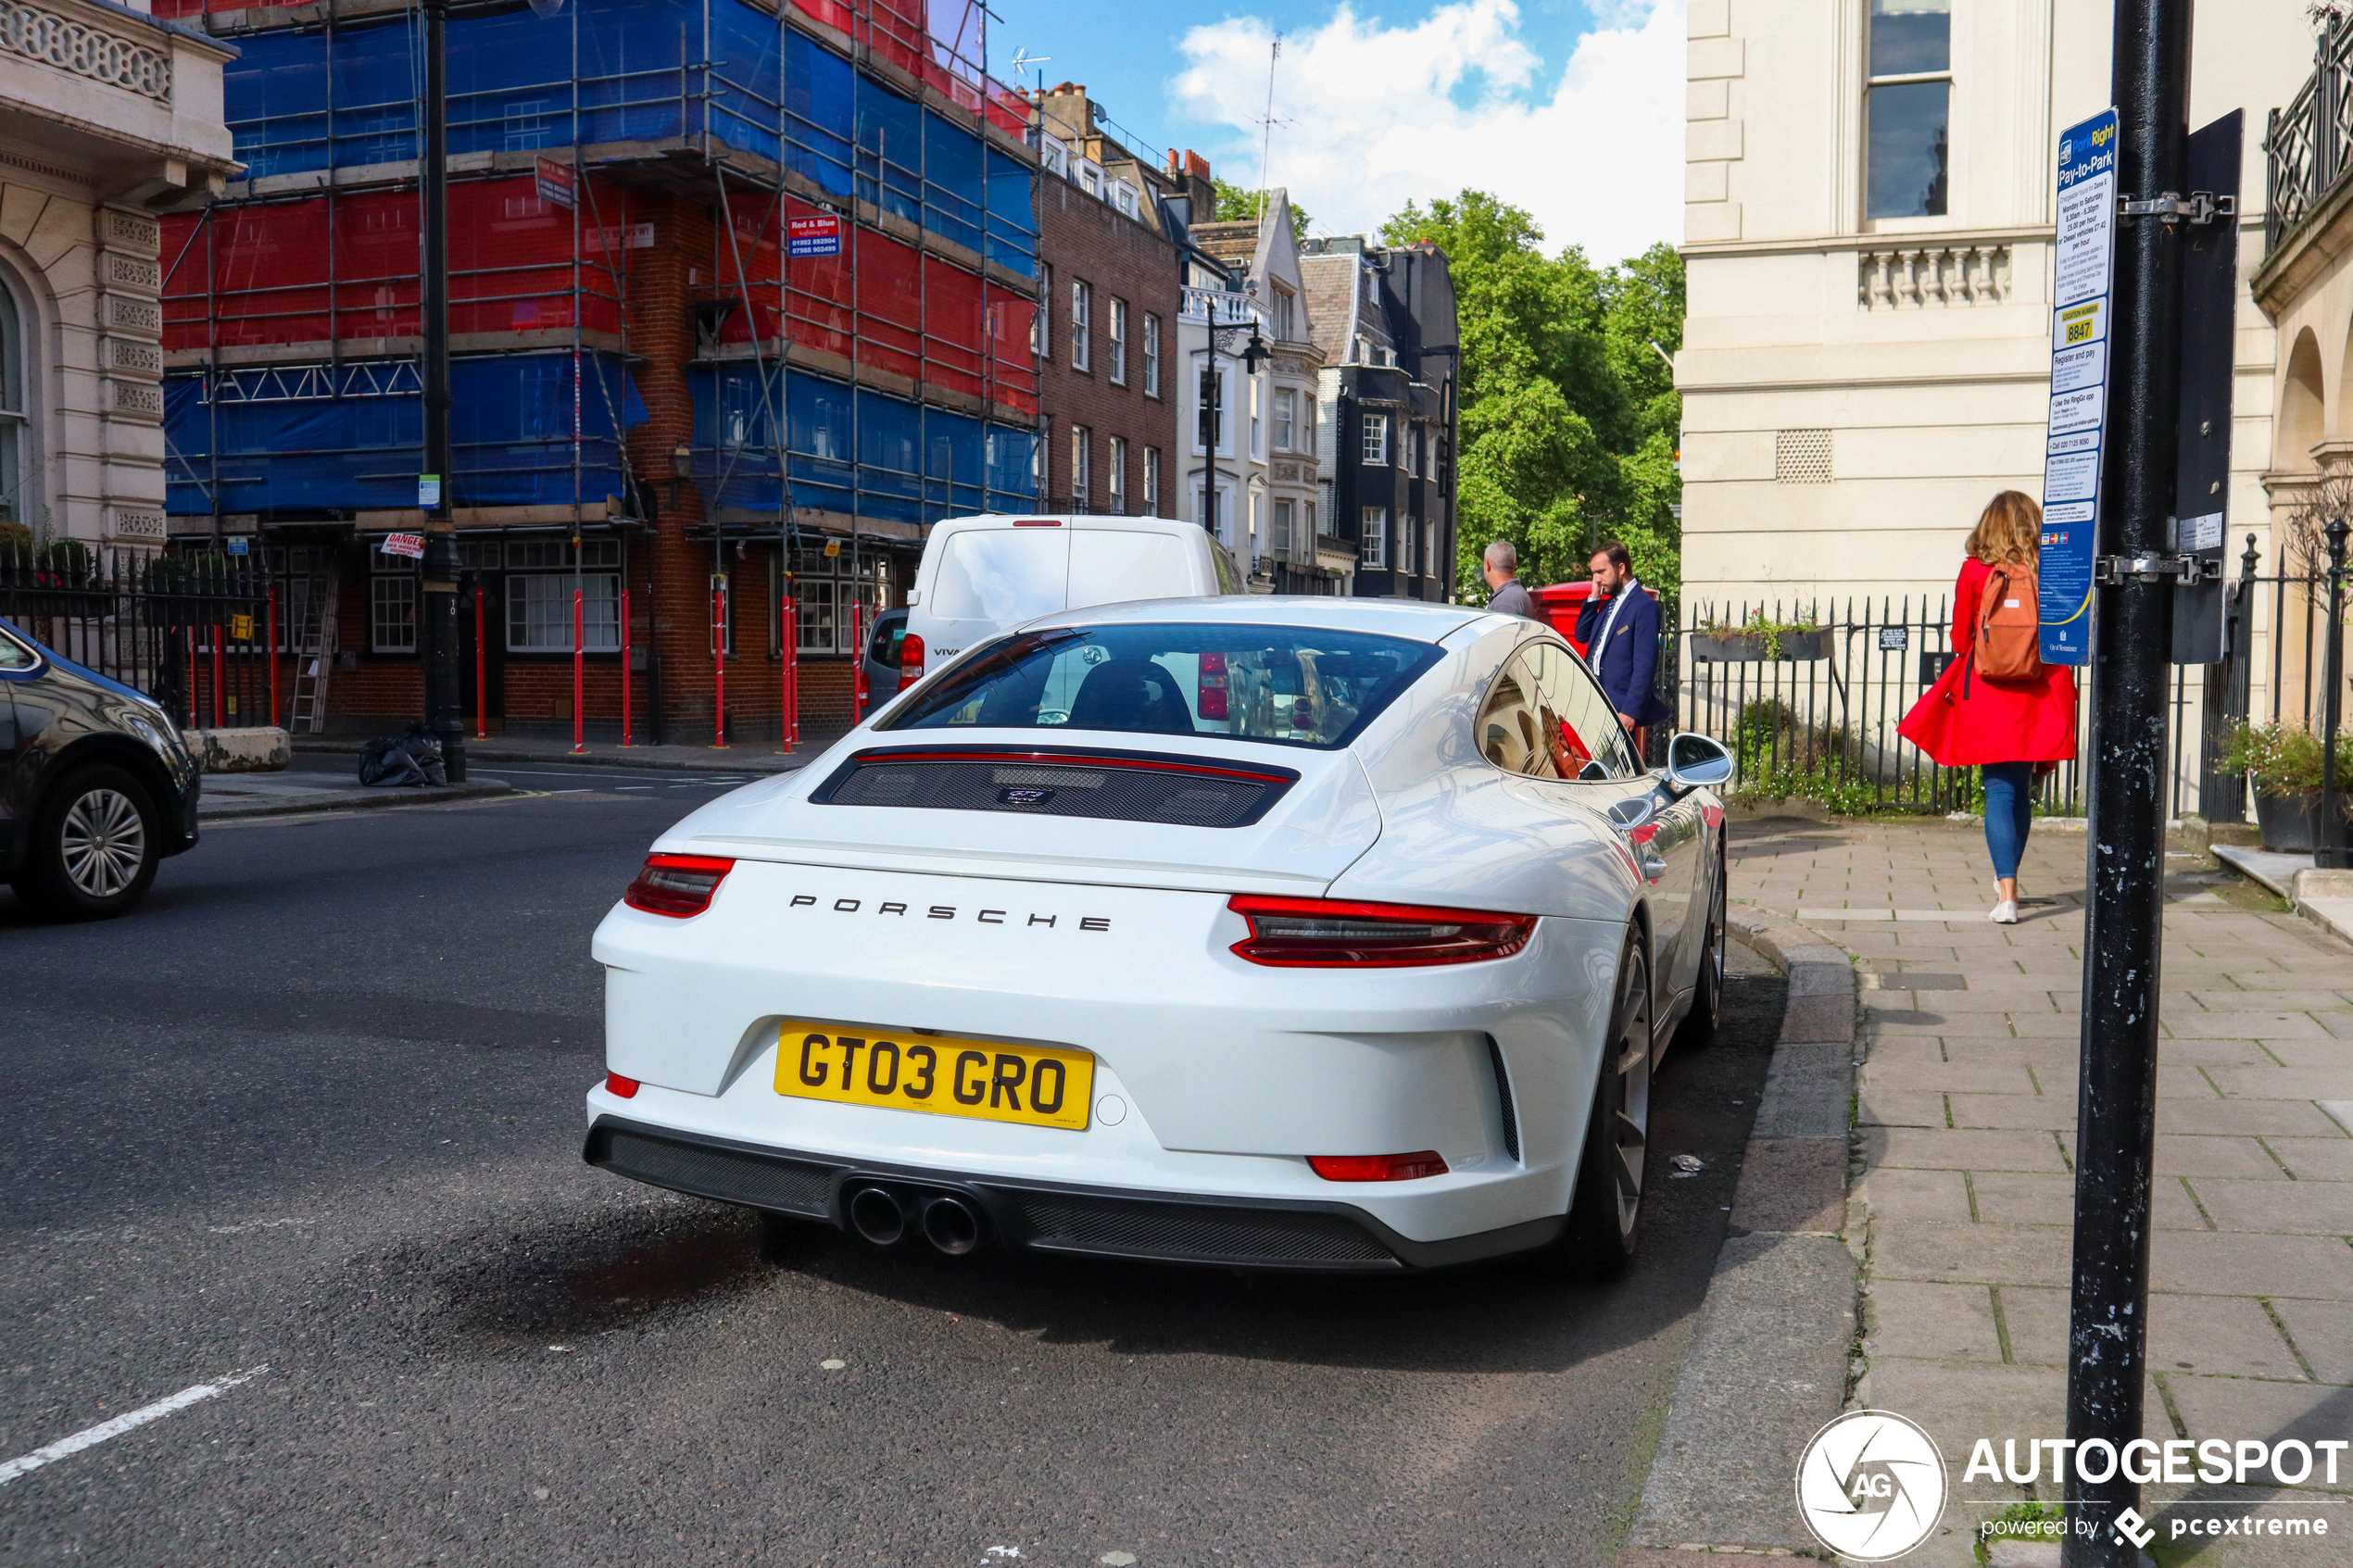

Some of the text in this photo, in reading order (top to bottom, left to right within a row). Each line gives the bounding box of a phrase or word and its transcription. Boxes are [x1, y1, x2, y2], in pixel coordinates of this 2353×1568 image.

[2073, 123, 2114, 155] ParkRight
[2059, 150, 2113, 187] Pay-to-Park
[2094, 181, 2103, 189] Zone
[2063, 202, 2078, 213] Monday
[2085, 192, 2104, 204] Saturday
[2066, 212, 2081, 222] 8.30am
[2067, 221, 2078, 232] £5.00
[2087, 215, 2097, 224] hour
[589, 227, 649, 240] HAS MWS W1
[799, 229, 820, 237] Scaffolding
[2064, 232, 2076, 243] Diesel
[2077, 226, 2094, 237] vehicles
[2094, 221, 2106, 232] £7.42
[2080, 238, 2090, 246] hour
[2063, 305, 2098, 321] LOCATION NUMBER
[2068, 322, 2090, 341] 8847
[2055, 349, 2096, 365] Register and pay
[2071, 394, 2086, 404] RingGo
[2069, 439, 2079, 447] 7125
[2079, 438, 2089, 446] 9090
[389, 534, 420, 546] DANGE
[790, 895, 1111, 932] PORSCHE
[799, 1033, 1066, 1114] GT03 GRO
